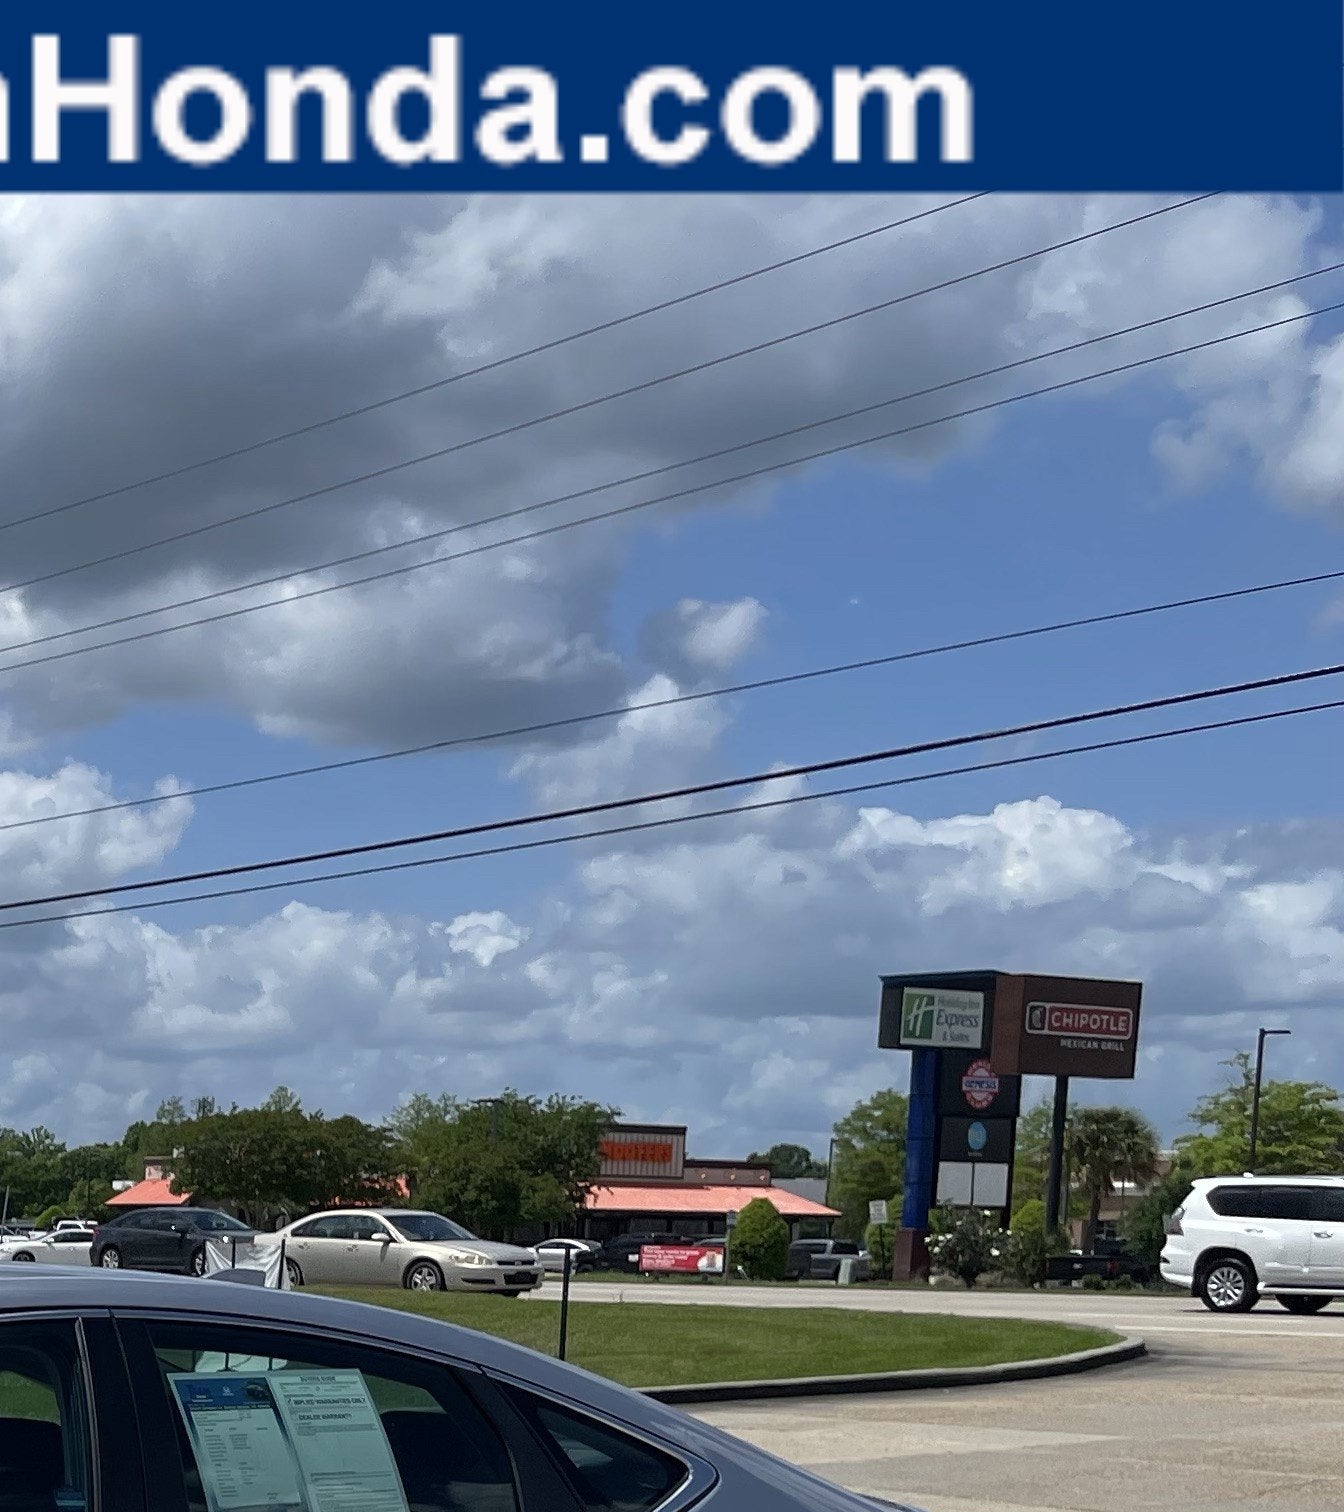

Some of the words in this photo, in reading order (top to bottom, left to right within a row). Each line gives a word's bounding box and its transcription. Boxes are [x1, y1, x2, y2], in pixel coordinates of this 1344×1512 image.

[936, 1009, 979, 1030] Express
[1052, 1011, 1127, 1032] CHIPOTLE
[1060, 1039, 1098, 1049] MEXICAN
[1101, 1042, 1124, 1052] GRILL
